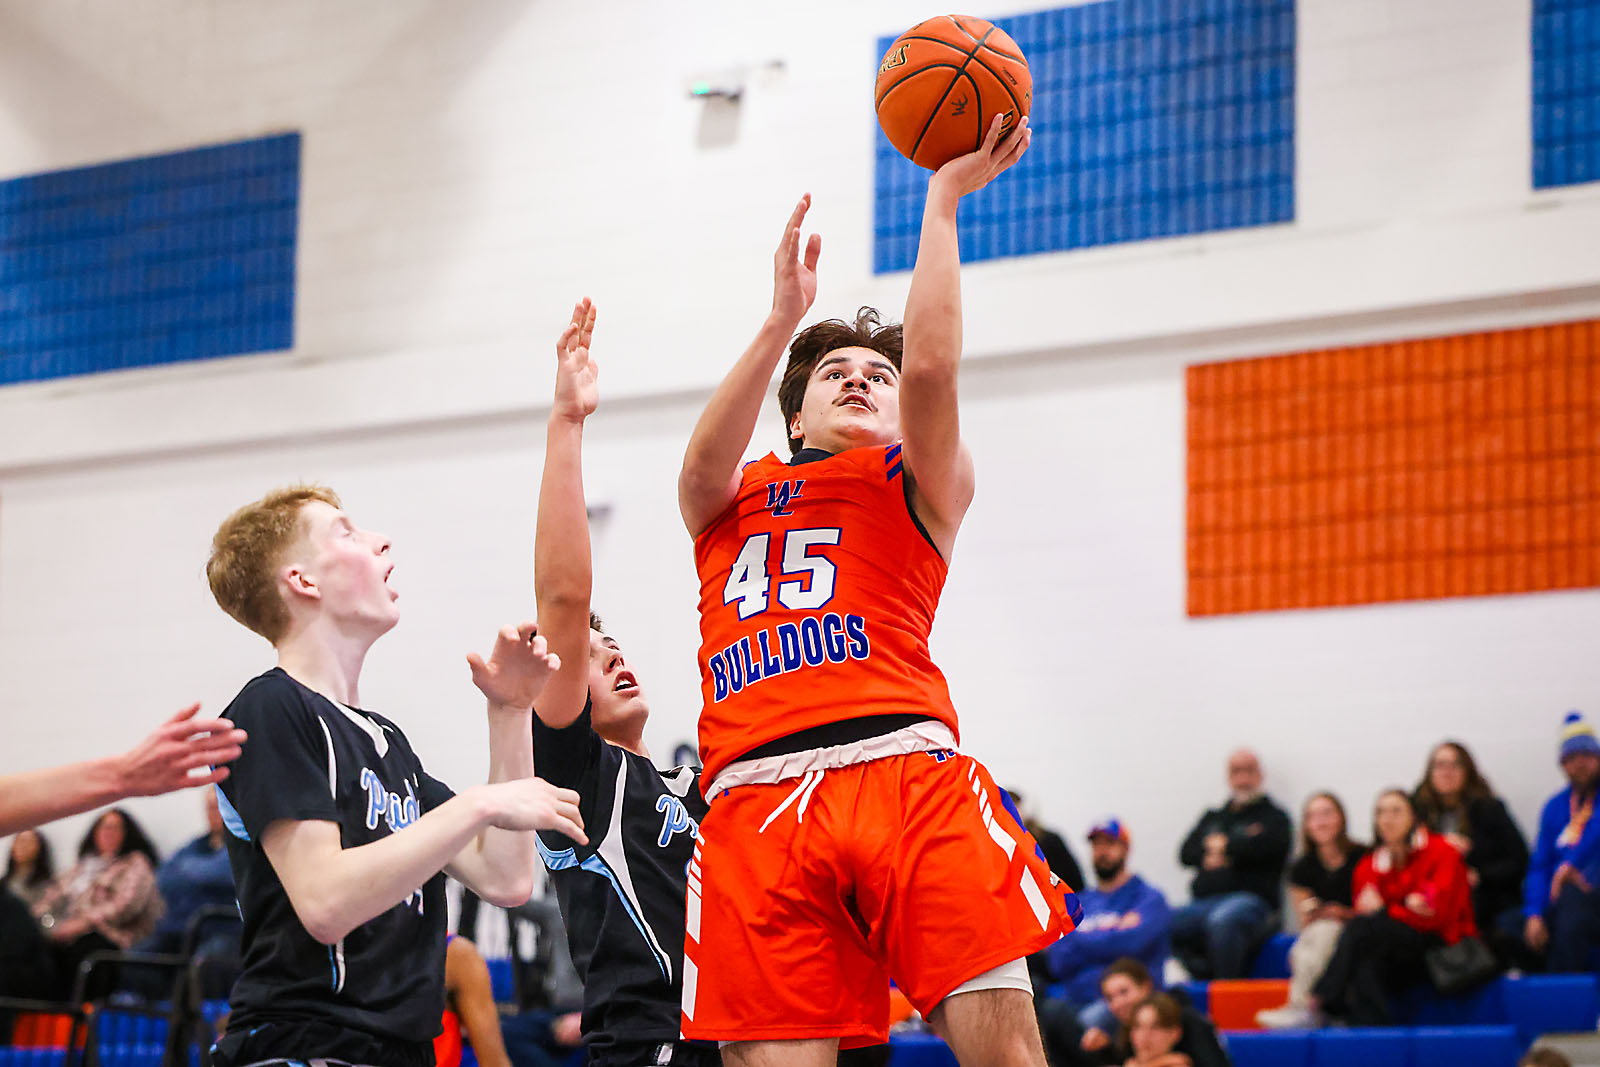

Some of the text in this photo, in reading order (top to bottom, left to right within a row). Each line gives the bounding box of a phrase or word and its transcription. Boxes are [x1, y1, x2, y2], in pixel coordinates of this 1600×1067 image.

[723, 527, 842, 621] 45
[709, 613, 870, 702] BULLDOGS
[360, 767, 421, 832] Prid
